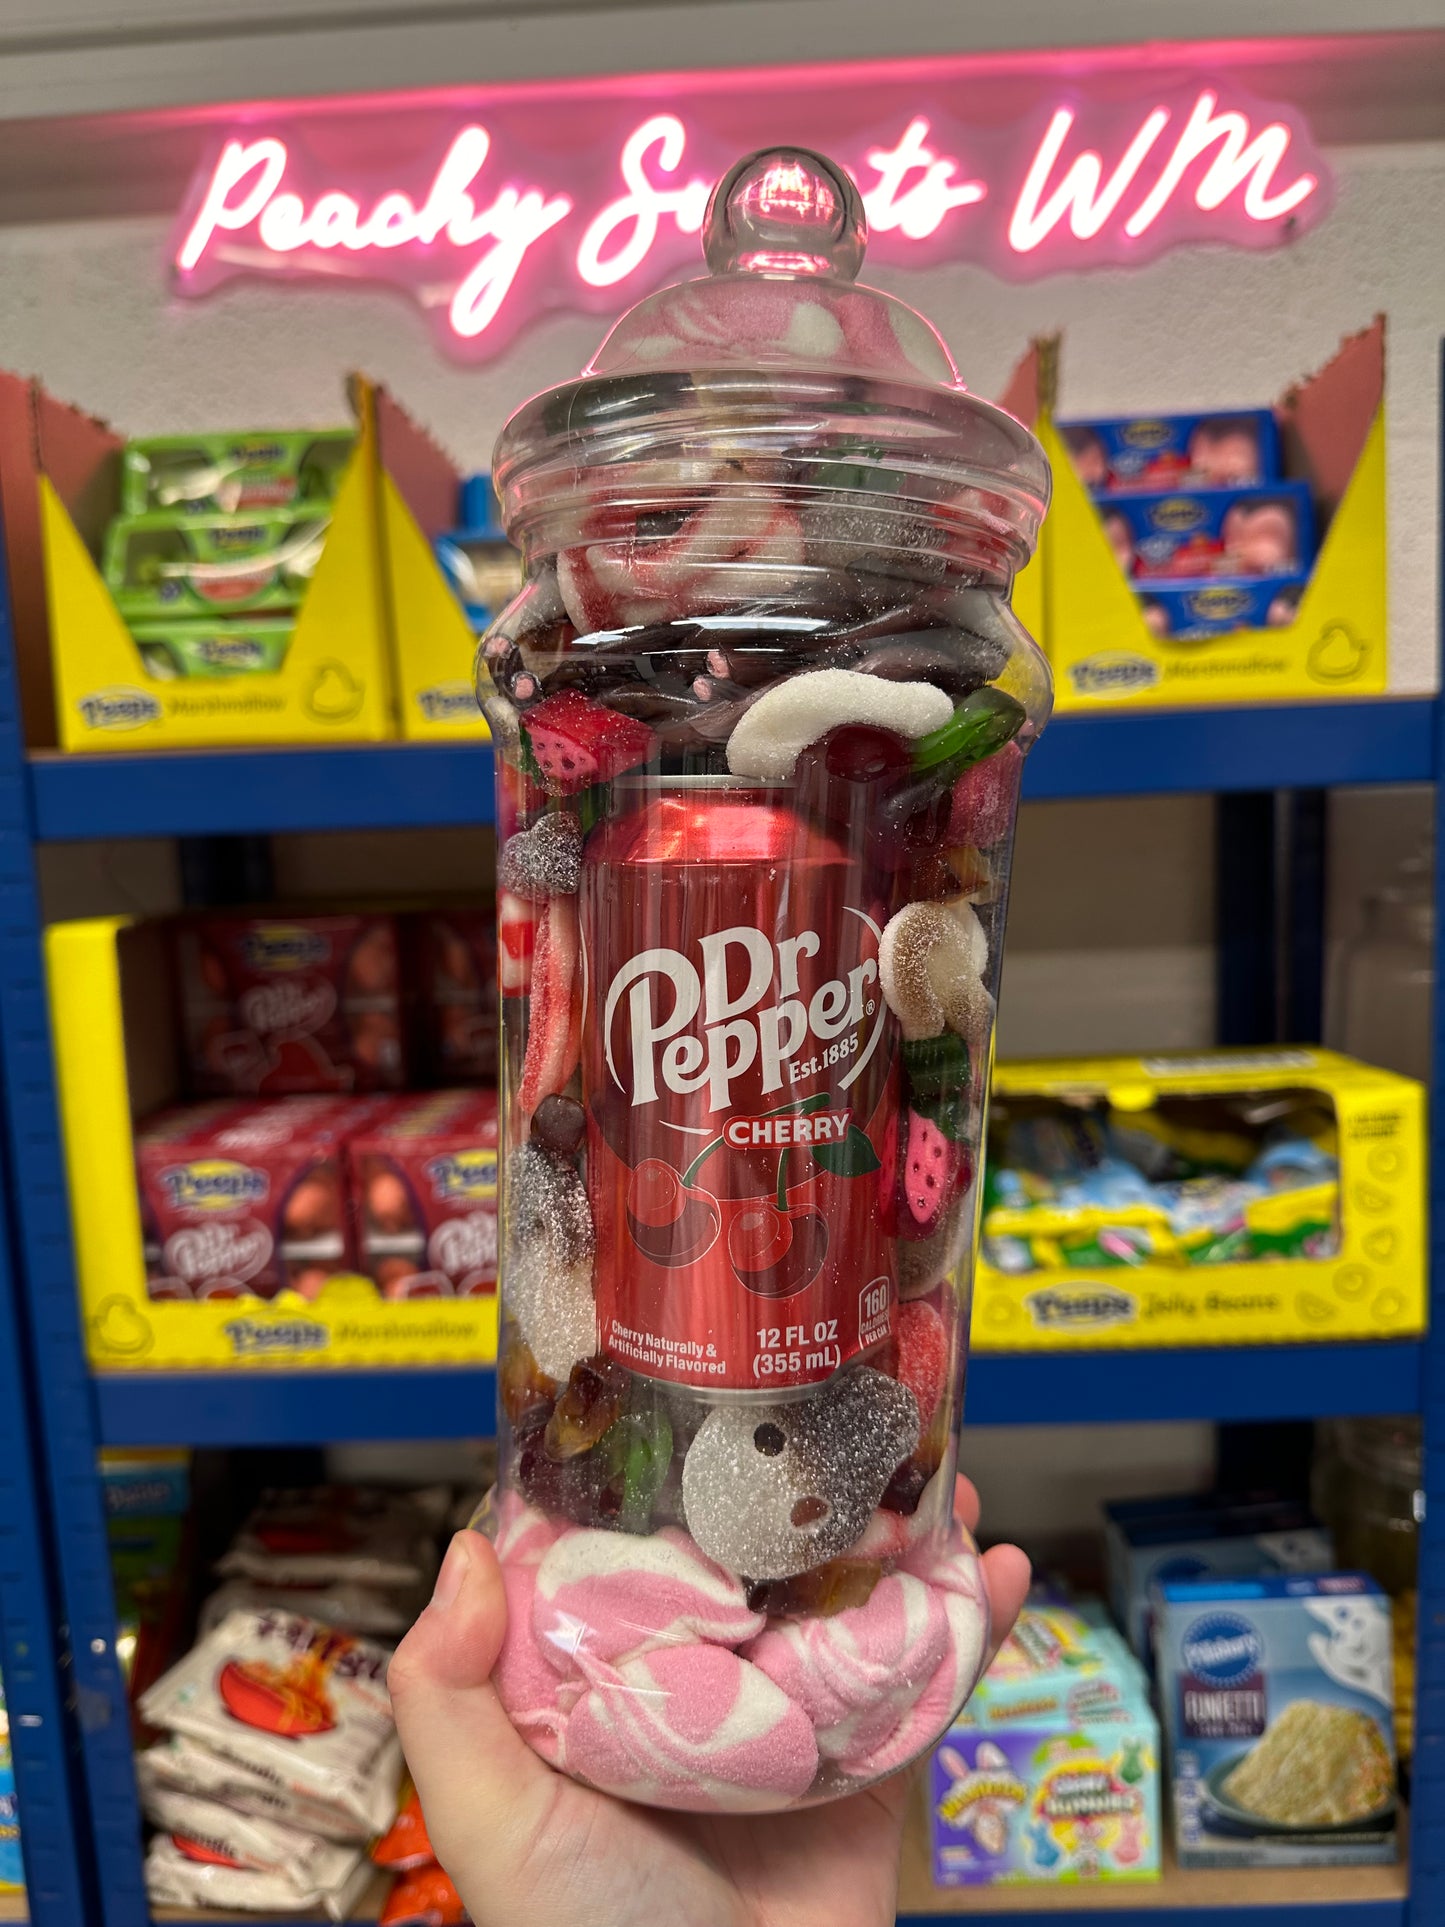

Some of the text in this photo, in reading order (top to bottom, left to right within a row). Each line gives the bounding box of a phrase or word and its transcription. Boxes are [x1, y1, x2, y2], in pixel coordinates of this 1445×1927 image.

[175, 88, 1319, 340] Peachy Sts WM
[697, 926, 821, 1026] Dr
[604, 947, 878, 1113] Pepper
[728, 1114, 849, 1145] CHERRY
[864, 1284, 887, 1319] 160
[611, 1319, 717, 1359] Cherry Naturally &
[756, 1319, 839, 1349] 12 FL OZ
[865, 1330, 878, 1345] PER
[608, 1334, 726, 1374] Artificially Flavored
[752, 1345, 842, 1379] (355 mL)
